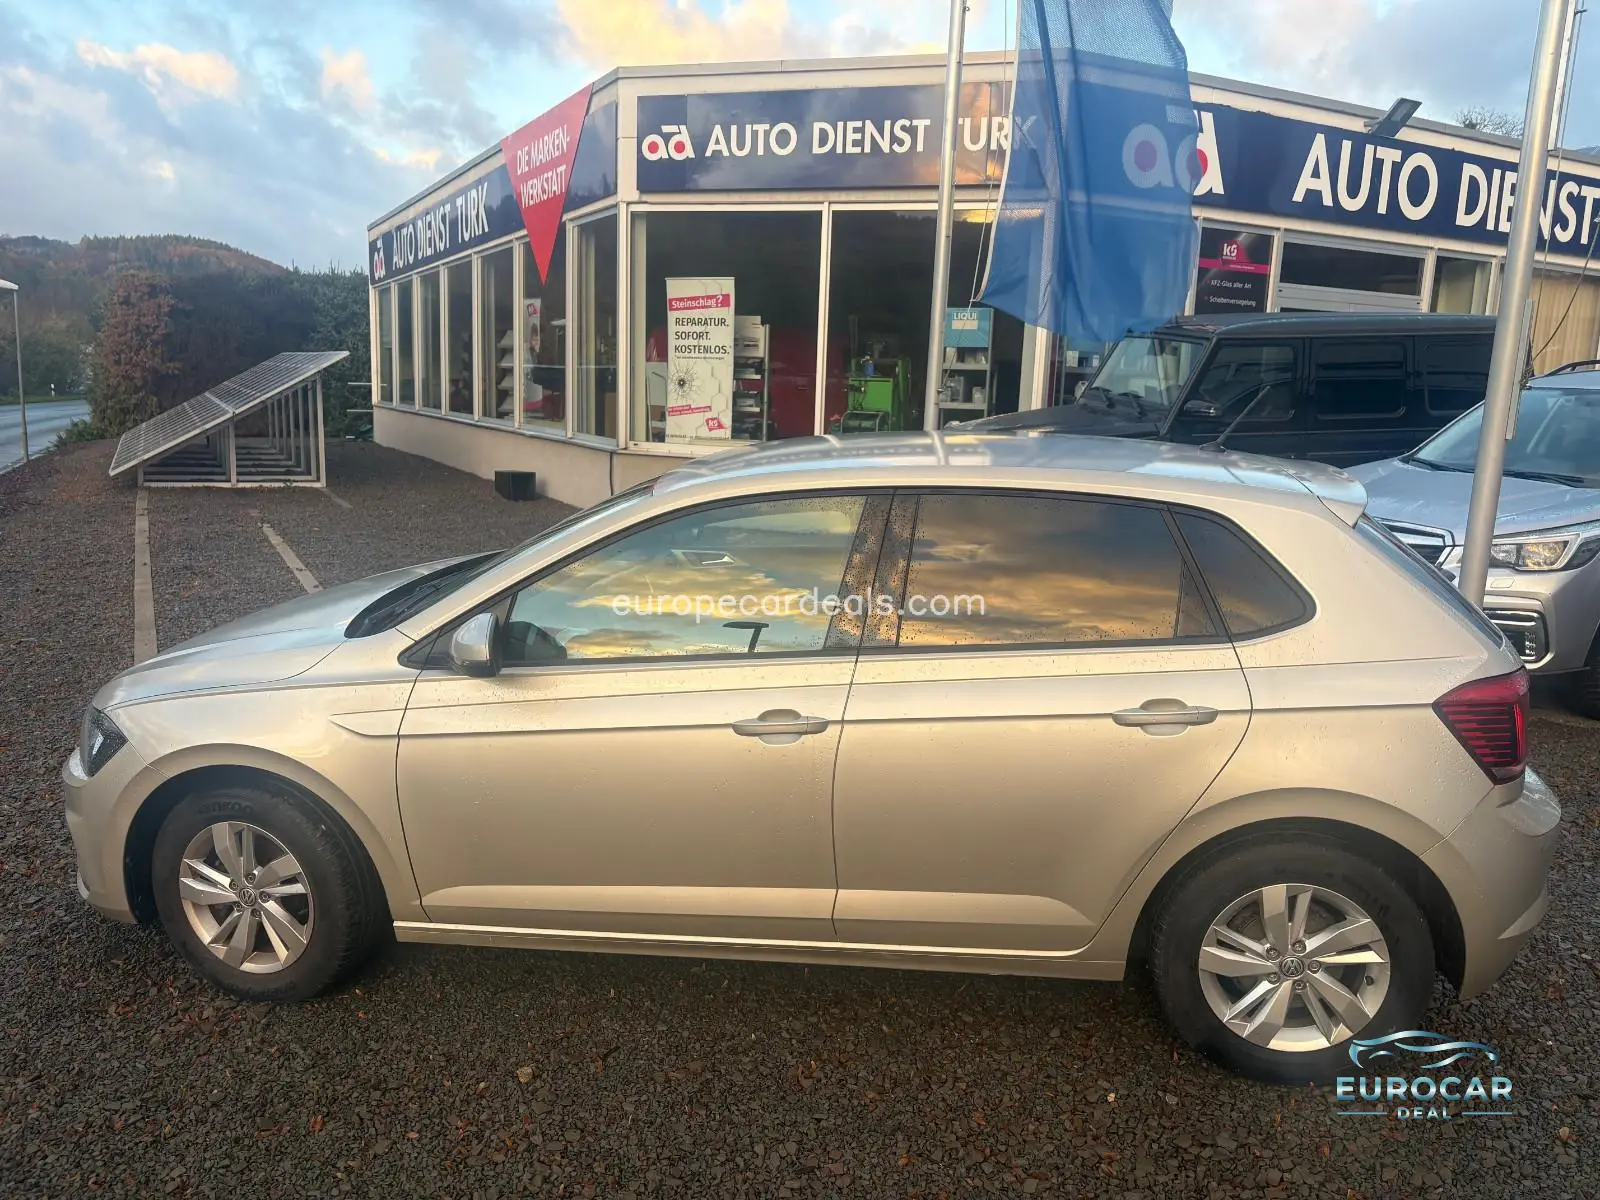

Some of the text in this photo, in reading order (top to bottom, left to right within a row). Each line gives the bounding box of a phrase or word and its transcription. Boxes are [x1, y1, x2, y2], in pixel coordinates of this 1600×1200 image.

[517, 124, 571, 176] DIE MARKEN-
[704, 122, 798, 157] AUTO
[811, 118, 931, 155] DIENST
[958, 116, 1038, 152] URK
[520, 164, 567, 209] WERKSTATT
[1291, 132, 1439, 221] AUTO
[1455, 162, 1600, 245] DIENST
[392, 222, 415, 271] AUTO
[417, 203, 451, 260] DIENST
[456, 181, 489, 244] TURK
[671, 294, 723, 309] Steinschlag?
[953, 312, 977, 320] LIQUI
[674, 317, 729, 328] REPARATUR.
[674, 330, 711, 341] SOFORT.
